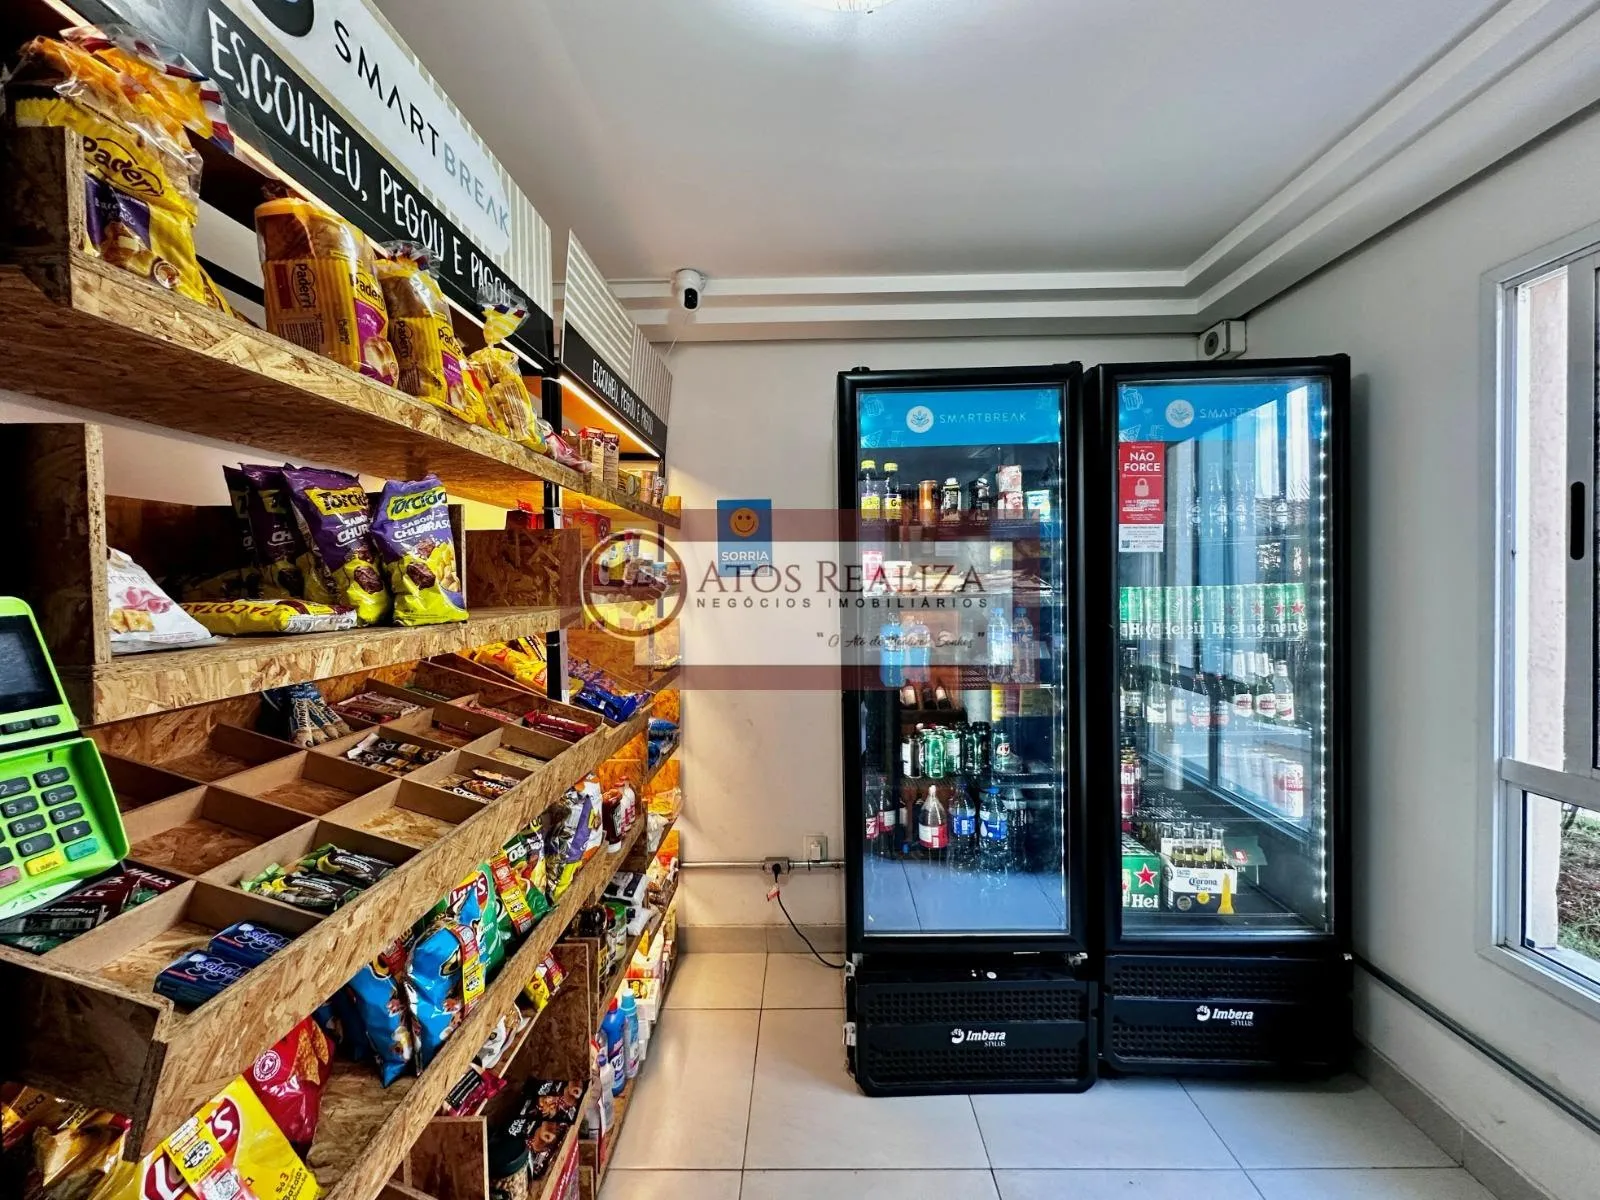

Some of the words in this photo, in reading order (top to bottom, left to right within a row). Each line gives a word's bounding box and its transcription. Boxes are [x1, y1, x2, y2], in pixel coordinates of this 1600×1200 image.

[208, 8, 368, 202] ESCOLHEU,
[380, 167, 445, 262] PEGOU
[453, 236, 464, 276] E
[940, 411, 1027, 424] SMARTBREAK
[1129, 449, 1155, 462] NÃO
[1123, 462, 1161, 472] FORCE
[721, 550, 769, 561] SORRIA
[40, 773, 50, 784] 3
[0, 783, 8, 795] 2
[49, 792, 58, 802] 6
[8, 803, 17, 814] 5
[56, 810, 65, 820] 9
[15, 822, 25, 833] 8
[23, 842, 32, 852] 0
[1188, 876, 1218, 886] Corona
[1211, 1007, 1254, 1020] Imbera
[965, 1029, 1006, 1042] Imbera
